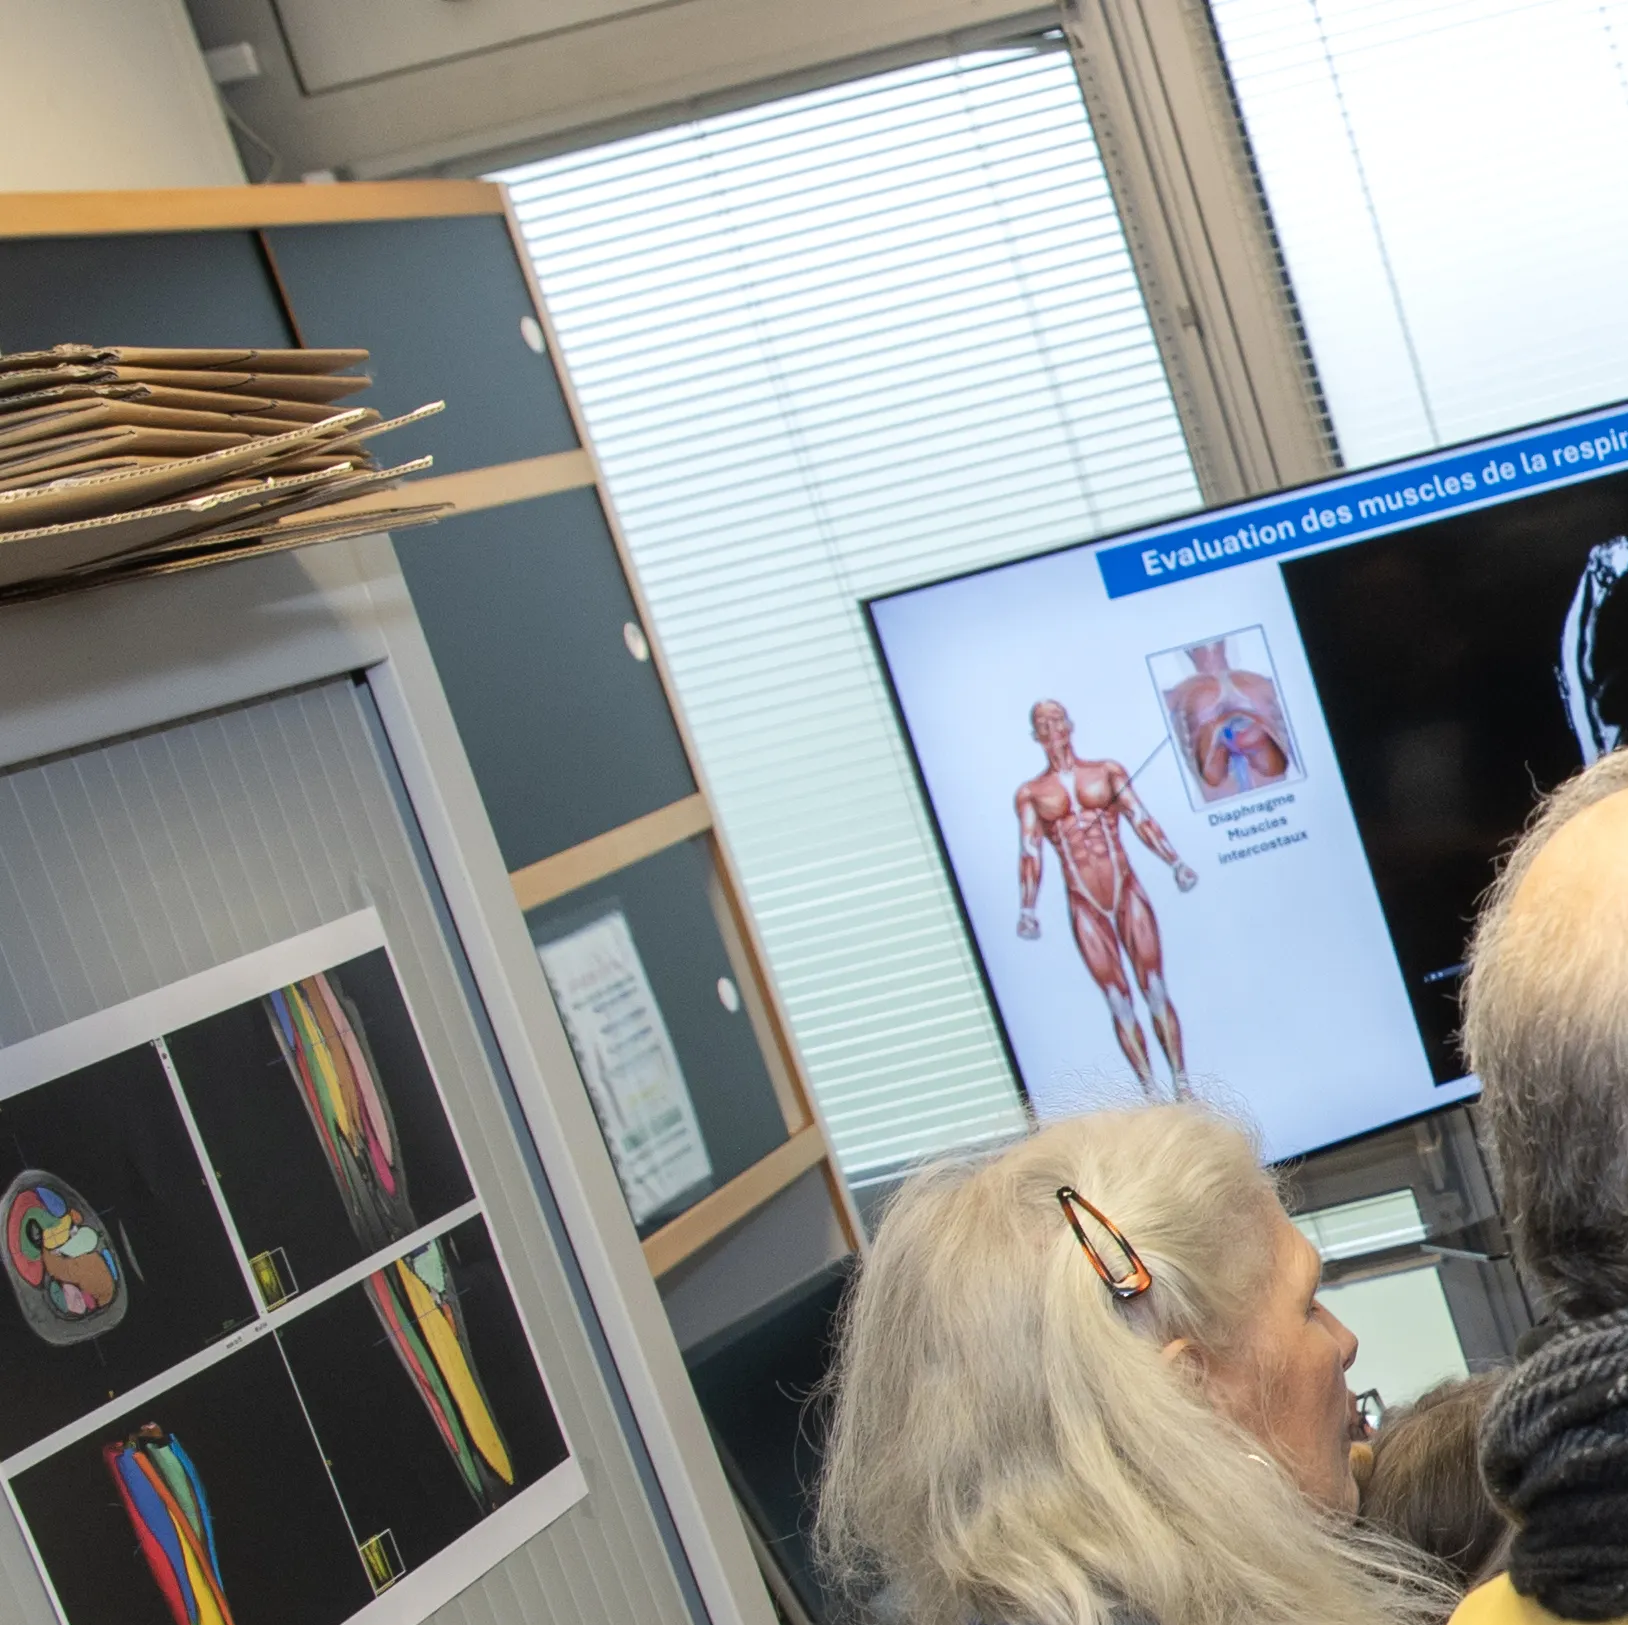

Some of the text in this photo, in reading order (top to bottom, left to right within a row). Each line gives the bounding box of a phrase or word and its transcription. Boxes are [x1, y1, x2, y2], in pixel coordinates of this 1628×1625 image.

[1142, 519, 1296, 576] Evaluation
[1301, 505, 1353, 534] des
[1358, 471, 1477, 519] muscles
[1482, 459, 1517, 486] de
[1520, 451, 1548, 475] la
[1208, 794, 1295, 827] Diaphragme
[1227, 816, 1287, 840] Muscles
[1218, 831, 1308, 864] intercostaux
